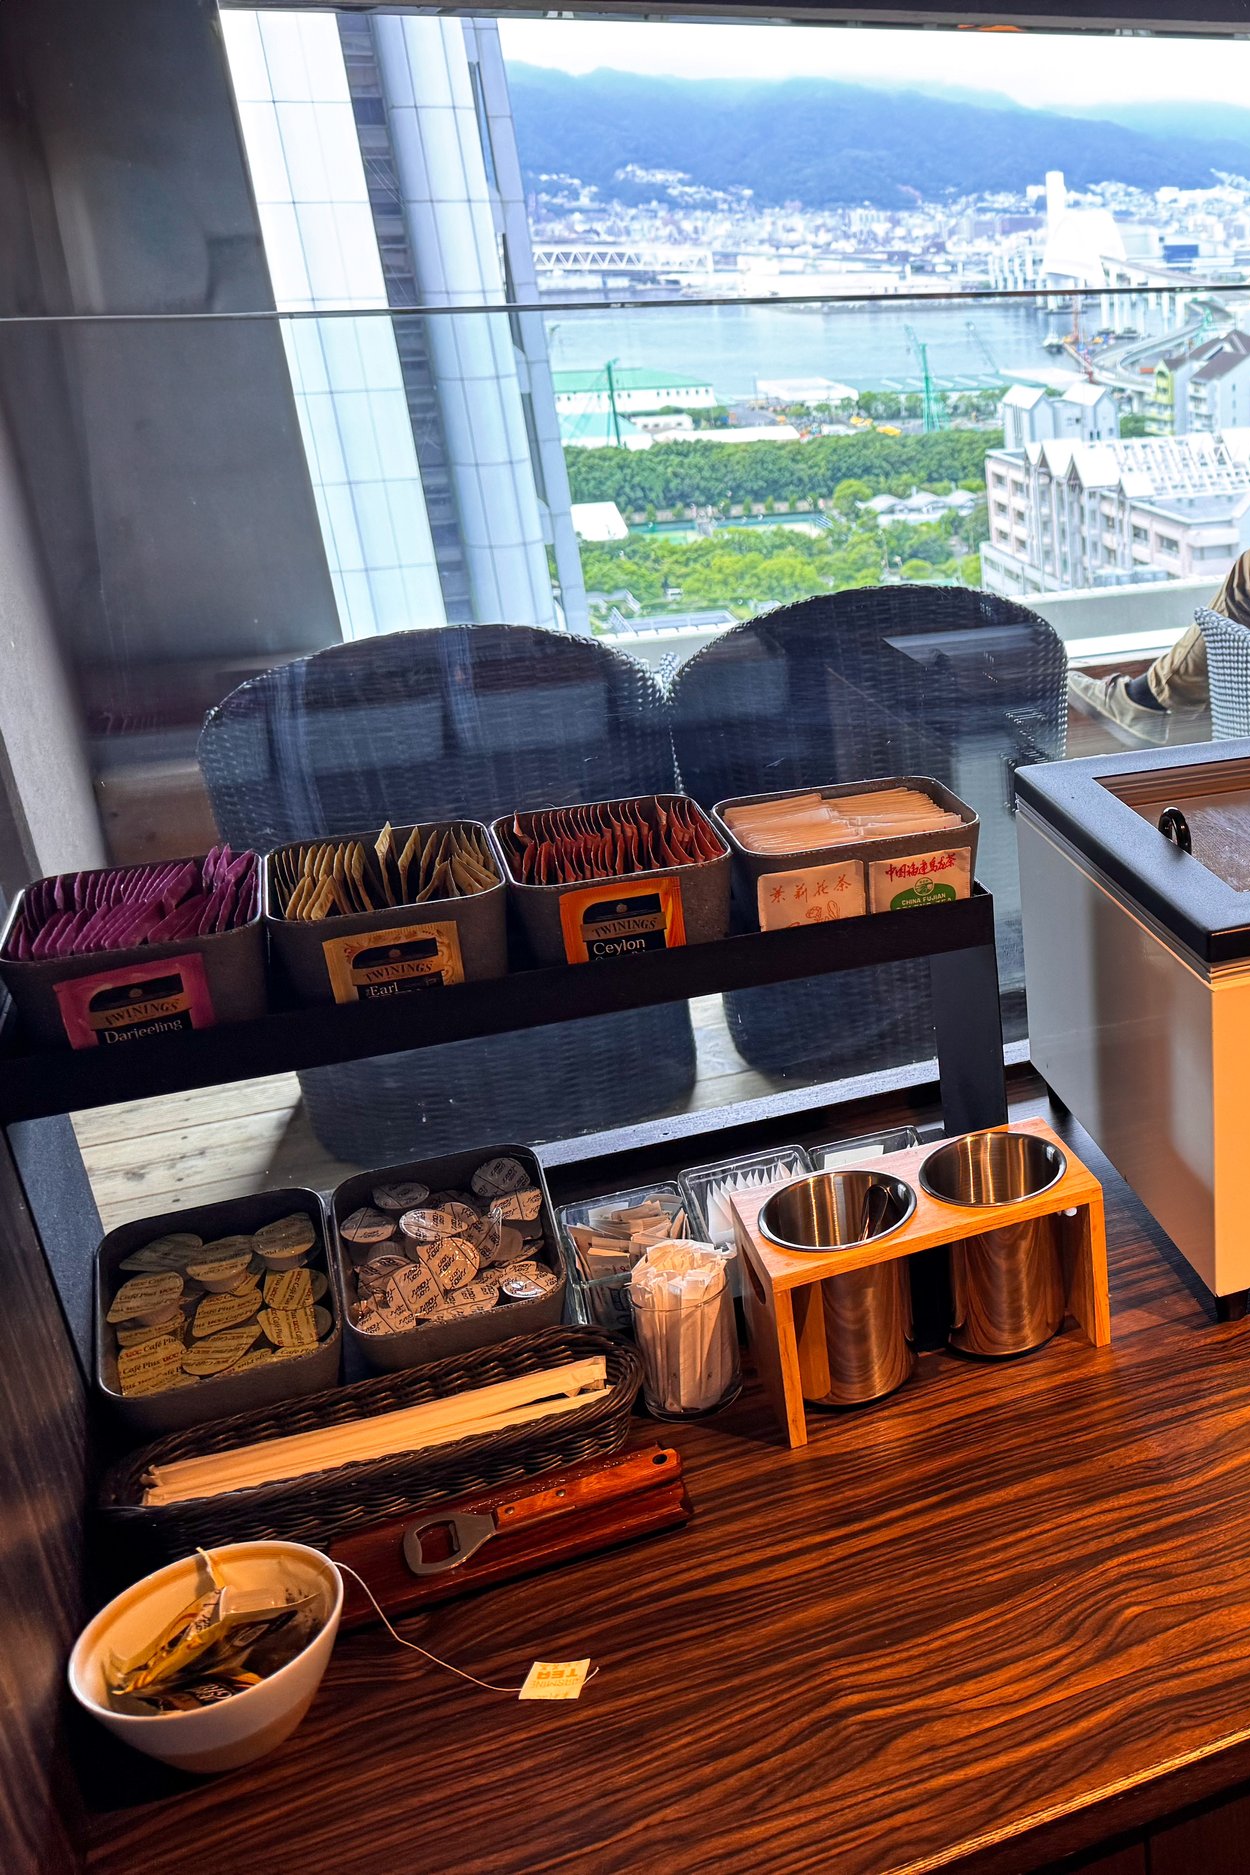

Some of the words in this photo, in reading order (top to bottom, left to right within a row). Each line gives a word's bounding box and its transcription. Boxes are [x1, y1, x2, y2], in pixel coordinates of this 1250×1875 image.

[901, 897, 921, 905] CHINA
[922, 892, 946, 902] FUJIAN
[591, 917, 658, 938] TWININGS
[593, 938, 645, 955] Ceylon
[364, 960, 434, 983] TWININGS
[370, 982, 398, 996] Earl
[104, 1000, 181, 1026] TWININGS
[104, 1019, 183, 1044] Darjeeling
[536, 1668, 578, 1680] TEA
